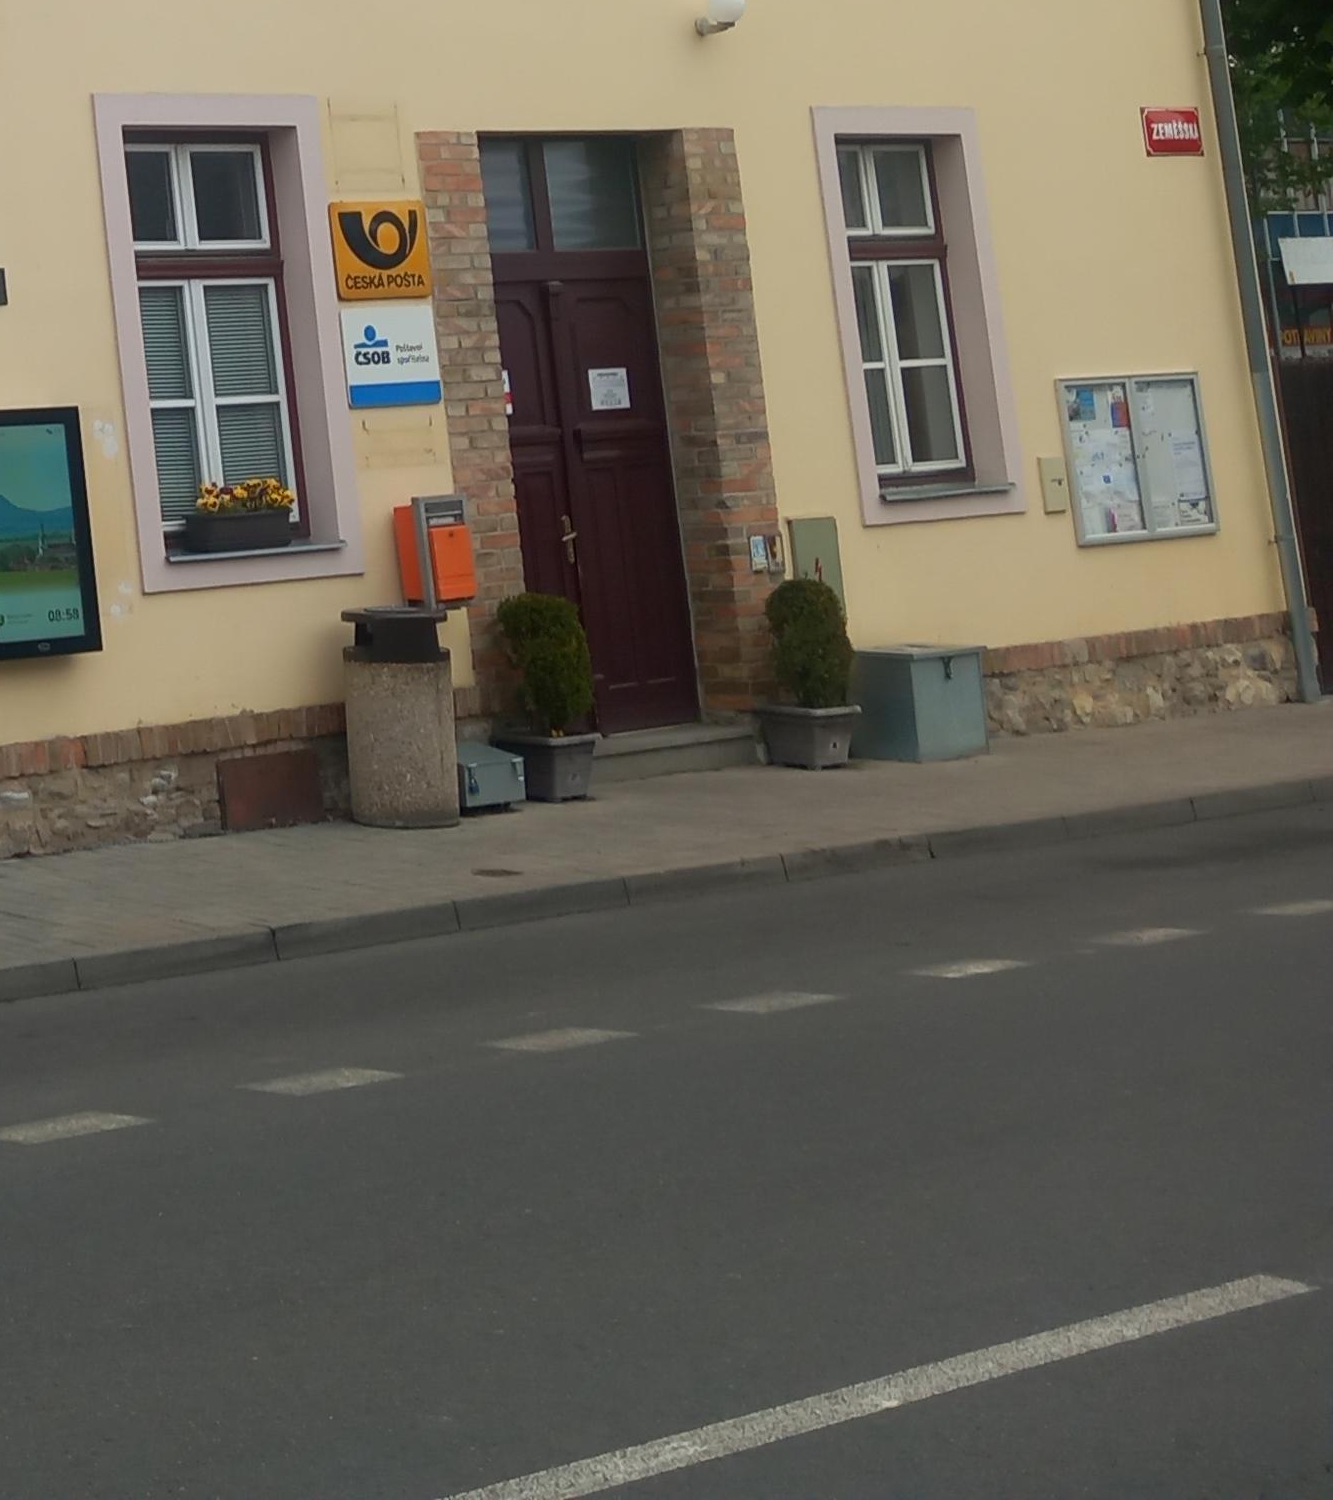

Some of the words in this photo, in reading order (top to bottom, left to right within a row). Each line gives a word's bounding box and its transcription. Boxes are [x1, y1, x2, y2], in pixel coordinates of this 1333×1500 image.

[344, 272, 386, 290] ČESKÁ
[386, 271, 425, 289] POŠTA
[354, 350, 391, 366] ČSOB
